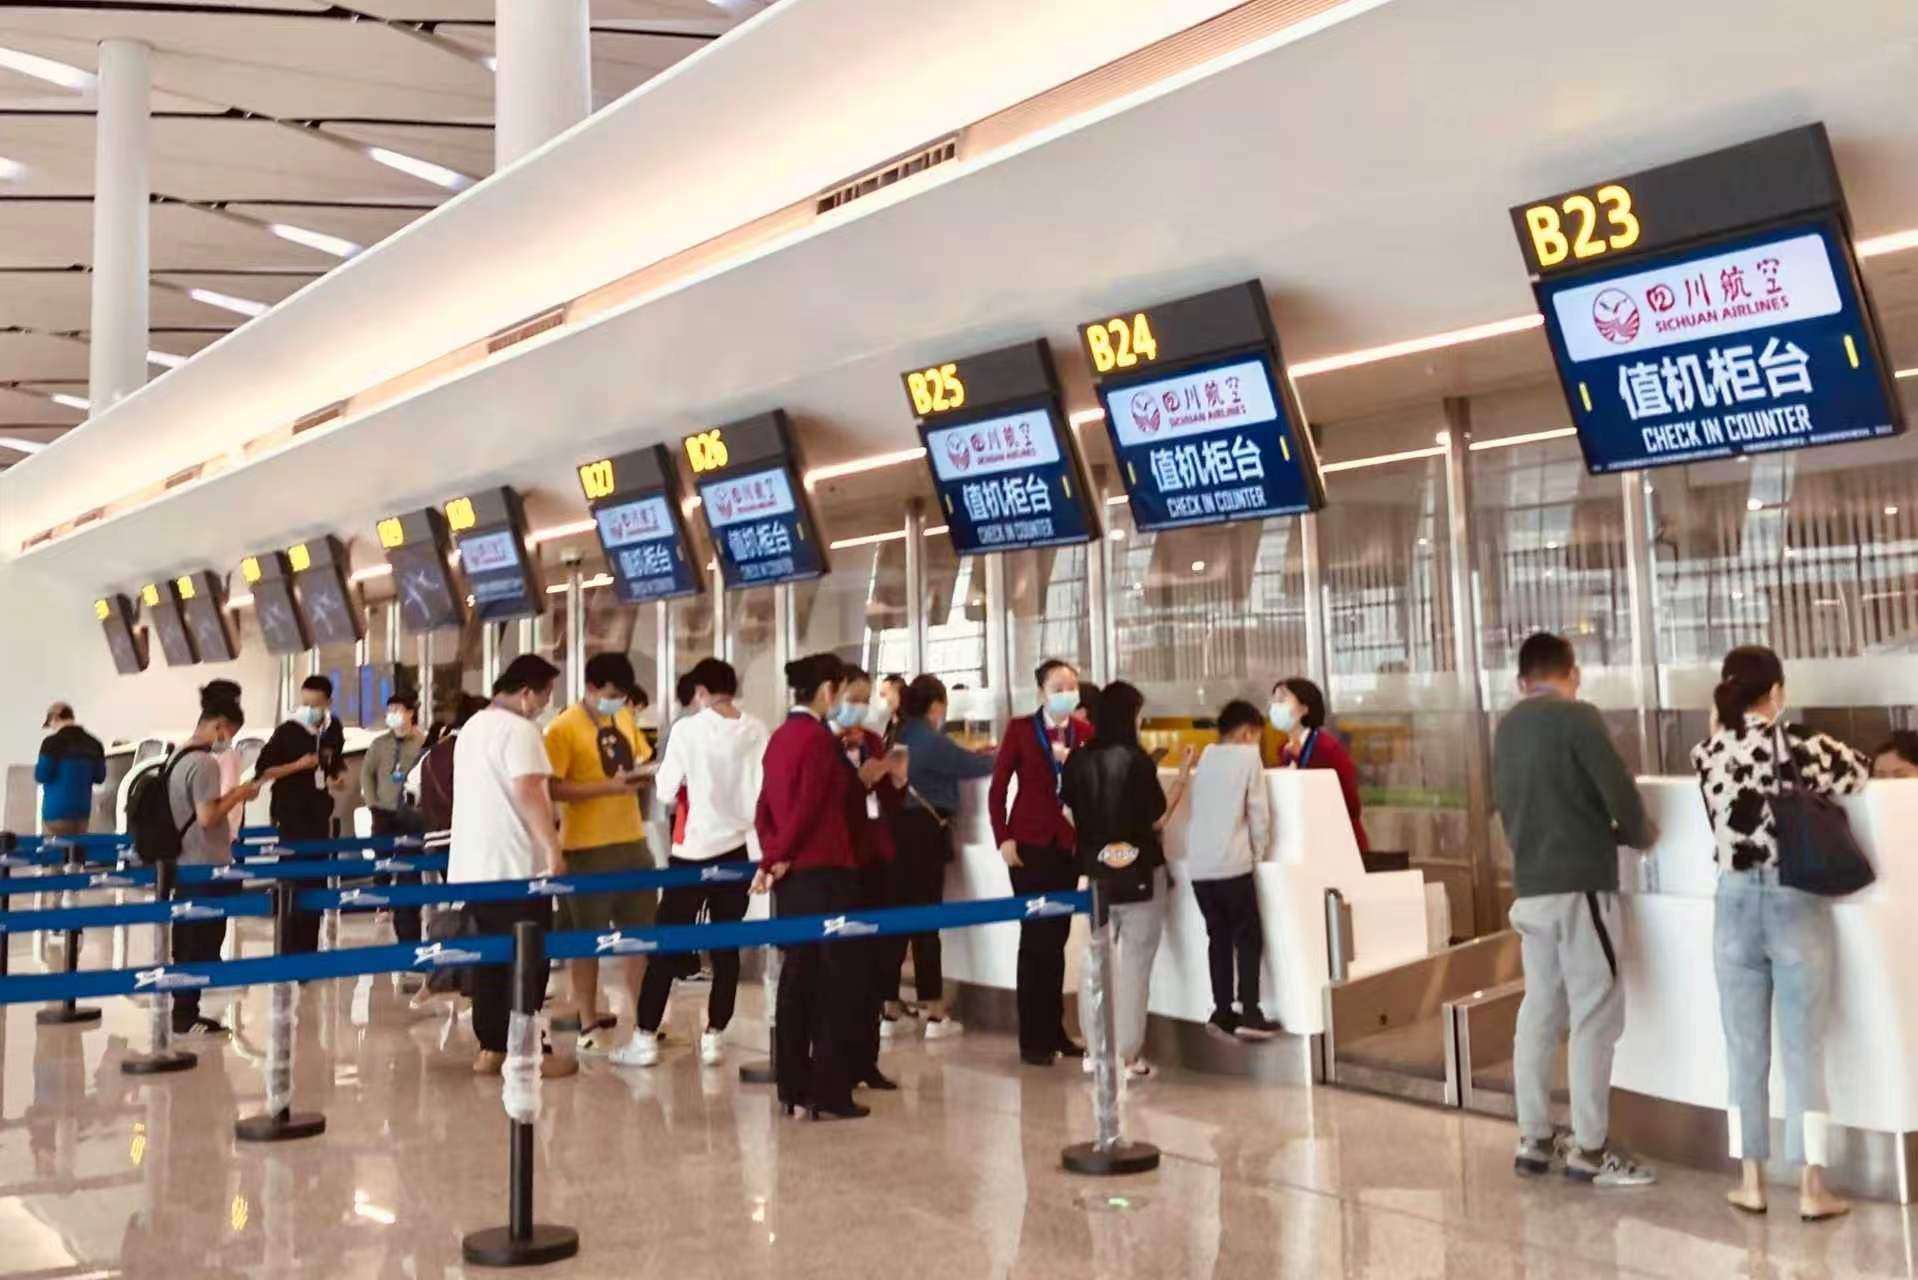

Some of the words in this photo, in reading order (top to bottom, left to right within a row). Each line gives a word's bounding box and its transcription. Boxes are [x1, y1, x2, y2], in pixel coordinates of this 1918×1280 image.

[1526, 185, 1640, 267] B23
[1646, 258, 1784, 313] 四川航空
[1655, 310, 1718, 333] SICHUAN
[1722, 296, 1790, 321] AIRLINES
[1087, 313, 1157, 372] B24
[907, 363, 965, 414] B25
[1162, 376, 1242, 412] 四川航空
[1618, 337, 1814, 420] 值机柜台
[1642, 420, 1699, 453] CHECK
[1700, 418, 1723, 444] IN
[1727, 404, 1813, 441] COUNTER
[1150, 435, 1265, 493] 值机柜台
[962, 473, 1052, 522] 值机柜台
[1167, 495, 1200, 518] CHECK
[1201, 493, 1216, 513] IN
[1216, 485, 1267, 513] COUNTER
